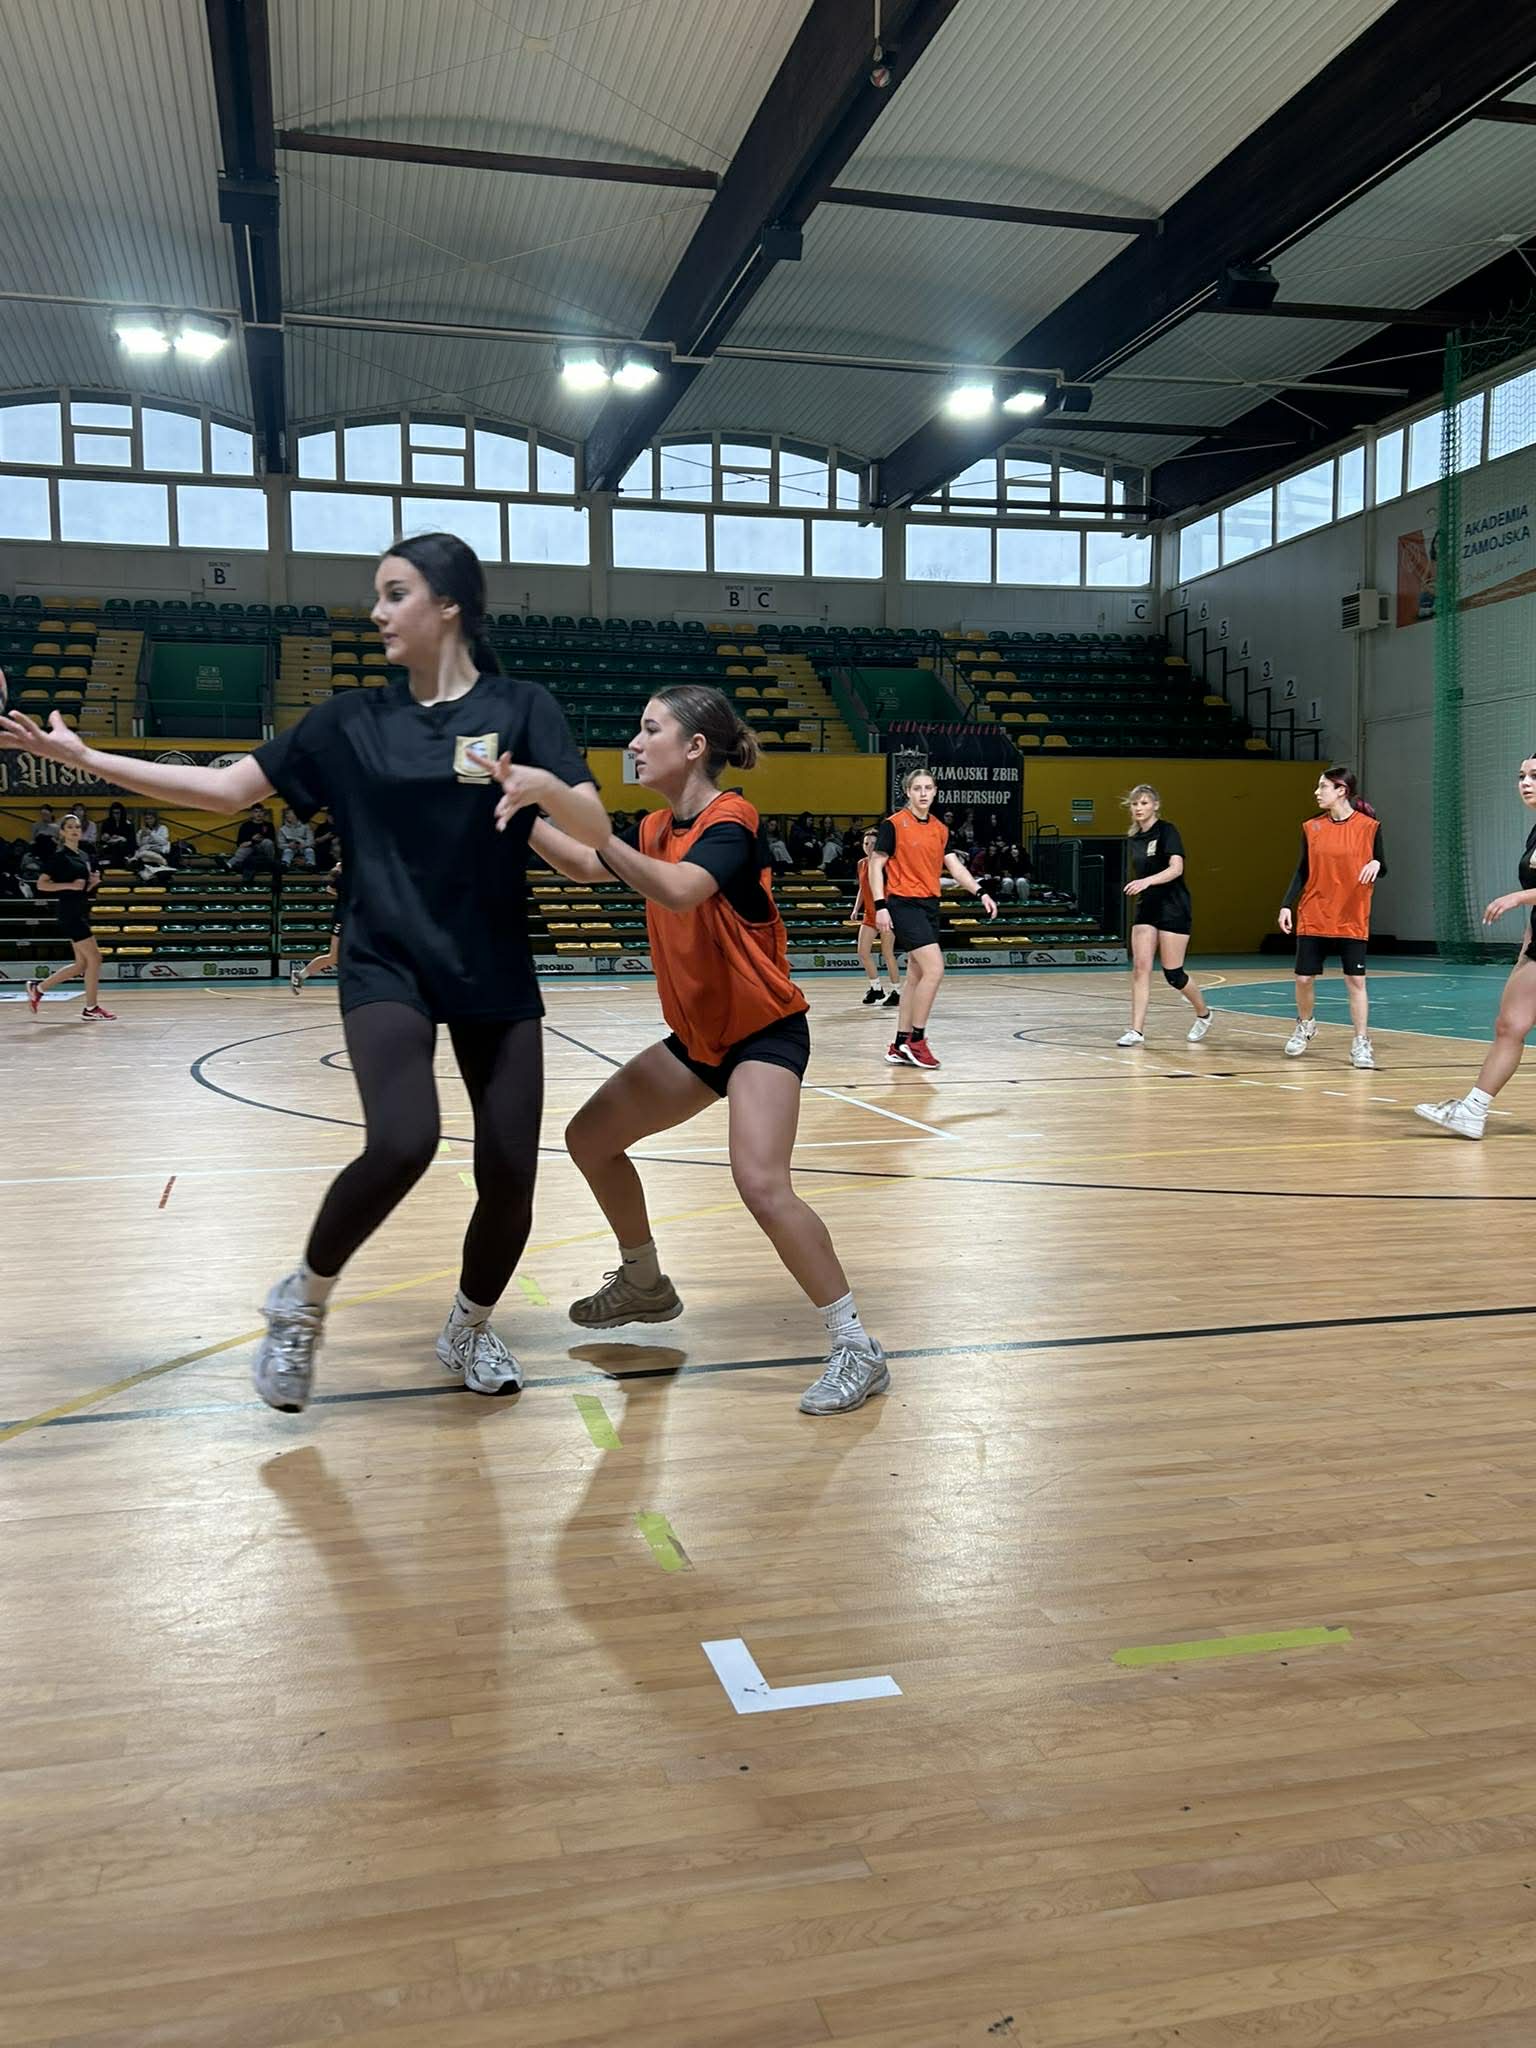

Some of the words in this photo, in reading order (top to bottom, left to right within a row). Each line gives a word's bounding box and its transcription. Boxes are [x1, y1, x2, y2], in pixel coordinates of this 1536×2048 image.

[1465, 505, 1529, 537] AKADEMIA
[1463, 526, 1531, 559] ZAMOJSKA
[214, 568, 226, 584] B
[730, 591, 740, 607] B
[758, 592, 769, 608] C
[1182, 588, 1188, 604] 7
[1134, 604, 1145, 619] C
[1200, 602, 1208, 619] 6
[1220, 620, 1228, 637] 5
[1240, 640, 1249, 657] 4
[1263, 661, 1271, 678] 3
[1286, 680, 1295, 697] 2
[1311, 702, 1317, 719] 1
[931, 766, 988, 781] ZAMOJSKI
[992, 767, 1019, 782] ZBIR
[938, 790, 1011, 804] BARBERSHOP
